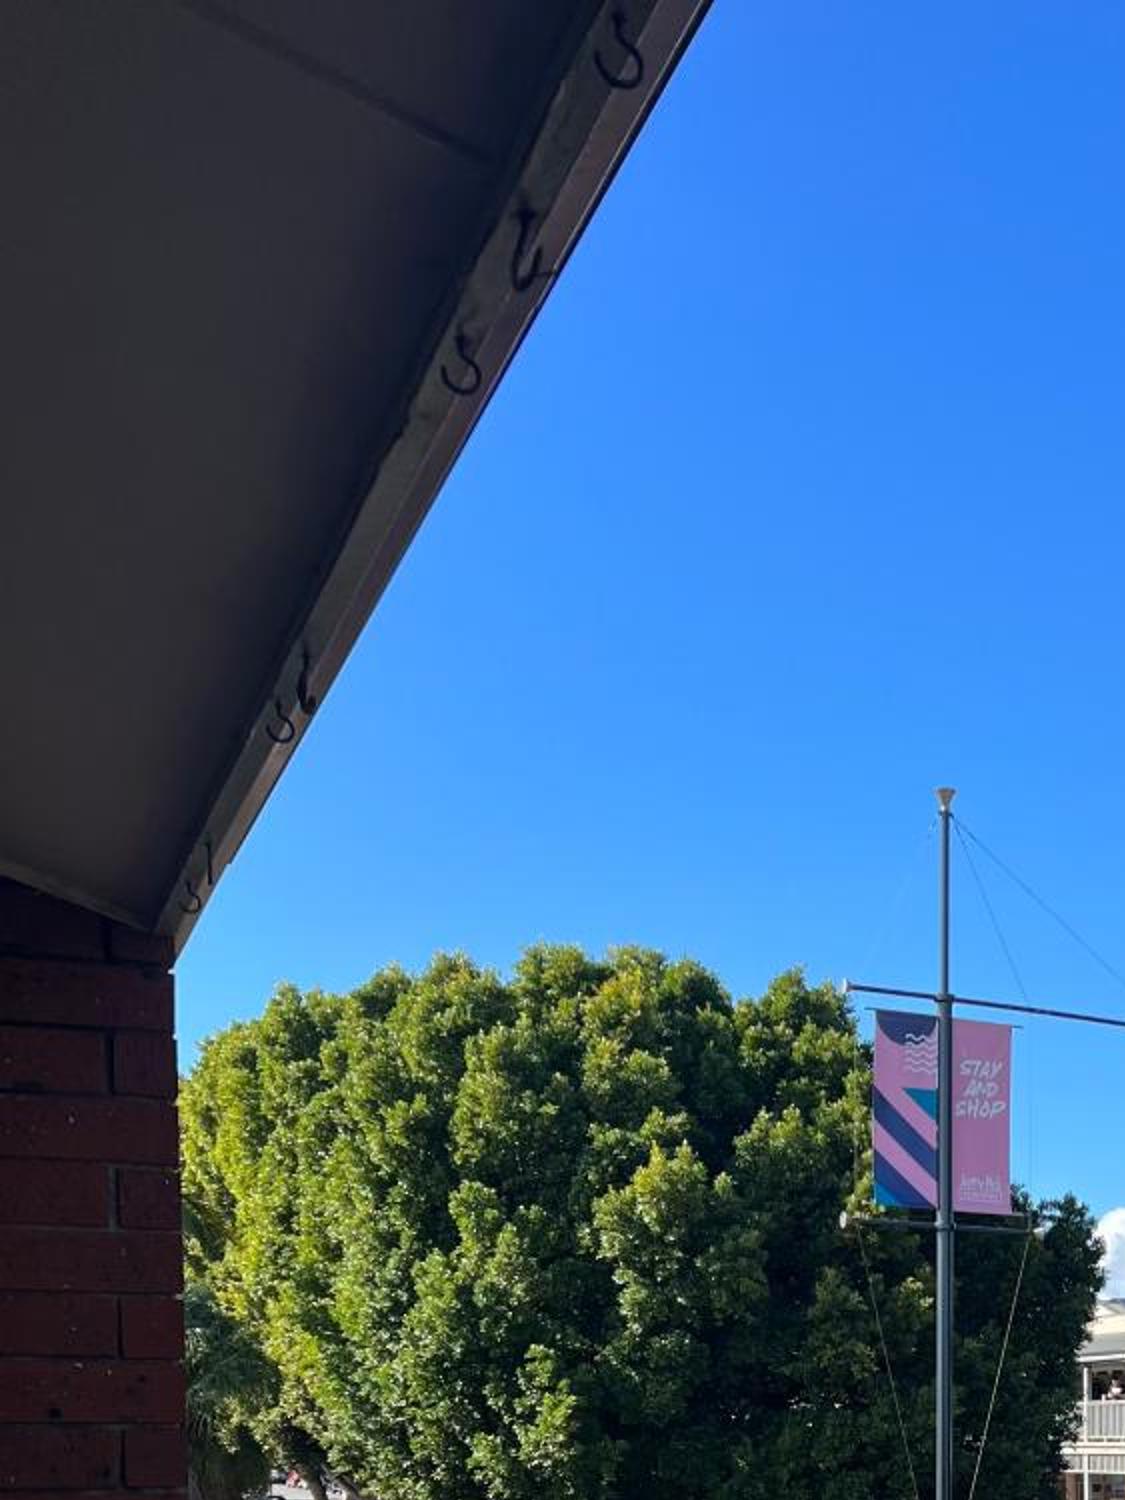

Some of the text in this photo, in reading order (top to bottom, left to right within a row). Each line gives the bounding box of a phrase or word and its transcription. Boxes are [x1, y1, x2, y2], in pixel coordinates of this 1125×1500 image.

[960, 1060, 1003, 1080] STAY
[963, 1079, 999, 1098] AND
[956, 1098, 1006, 1119] SHOP
